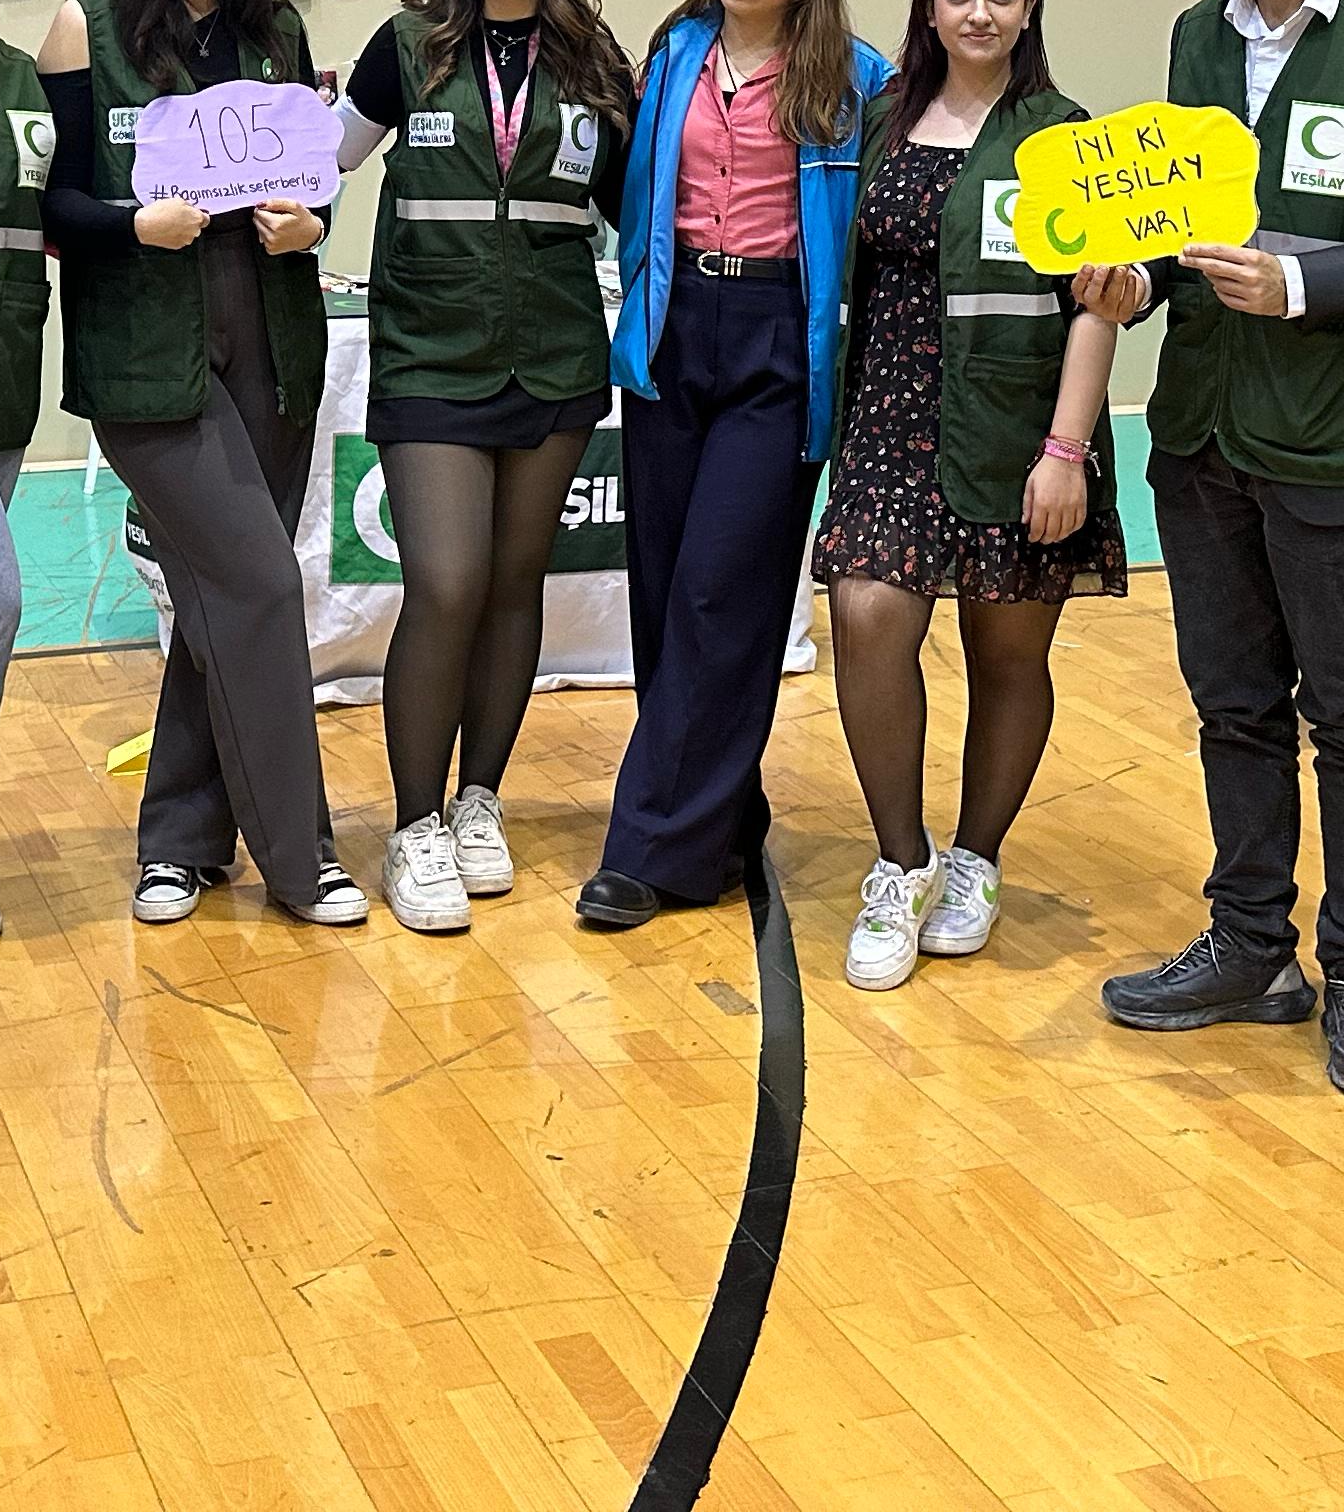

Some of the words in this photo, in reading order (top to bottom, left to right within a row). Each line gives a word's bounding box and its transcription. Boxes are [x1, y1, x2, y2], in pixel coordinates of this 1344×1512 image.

[189, 102, 284, 169] 105
[1072, 124, 1115, 164] İYİ
[1136, 116, 1166, 153] Kİ
[1071, 154, 1203, 203] YEŞİLAY
